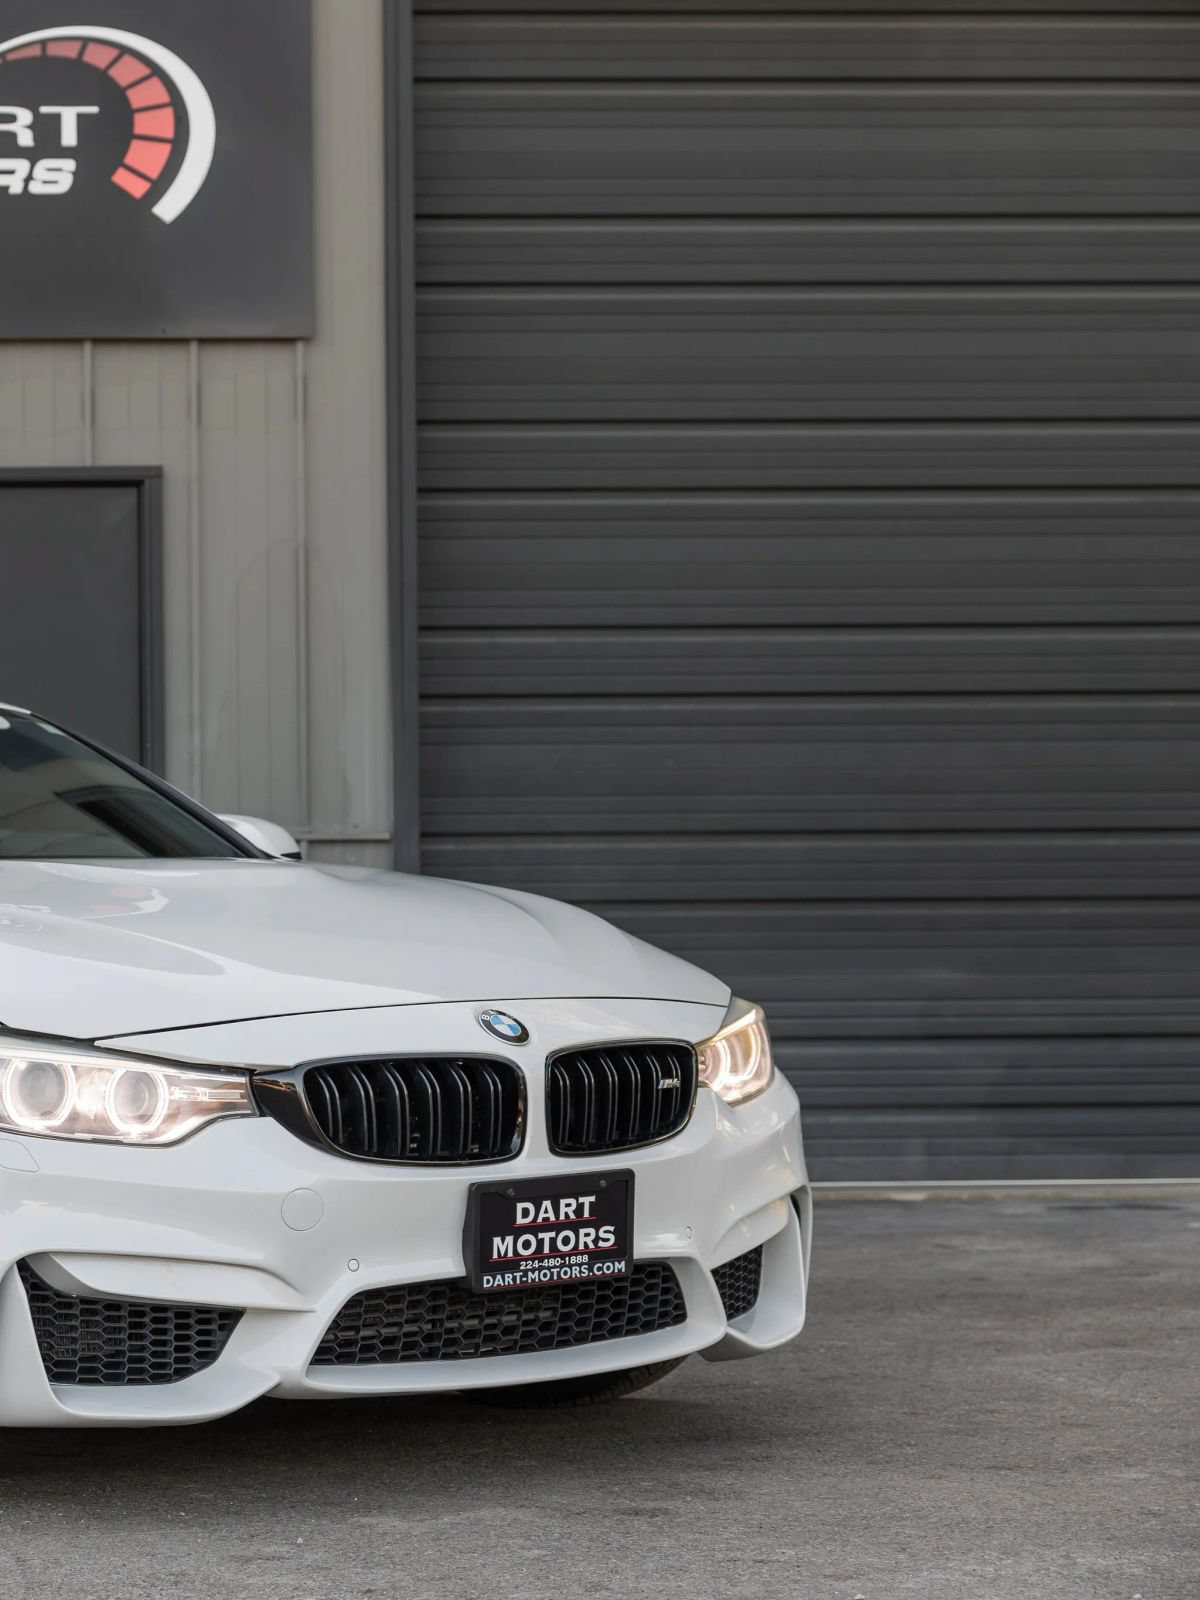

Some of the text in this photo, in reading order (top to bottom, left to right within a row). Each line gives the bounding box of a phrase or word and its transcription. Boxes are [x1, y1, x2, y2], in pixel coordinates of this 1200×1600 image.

[517, 1195, 596, 1225] DART
[492, 1226, 616, 1259] MOTORS
[483, 1260, 626, 1288] DART-MOTORS.COM
[520, 1255, 588, 1270] 224-480-1888
